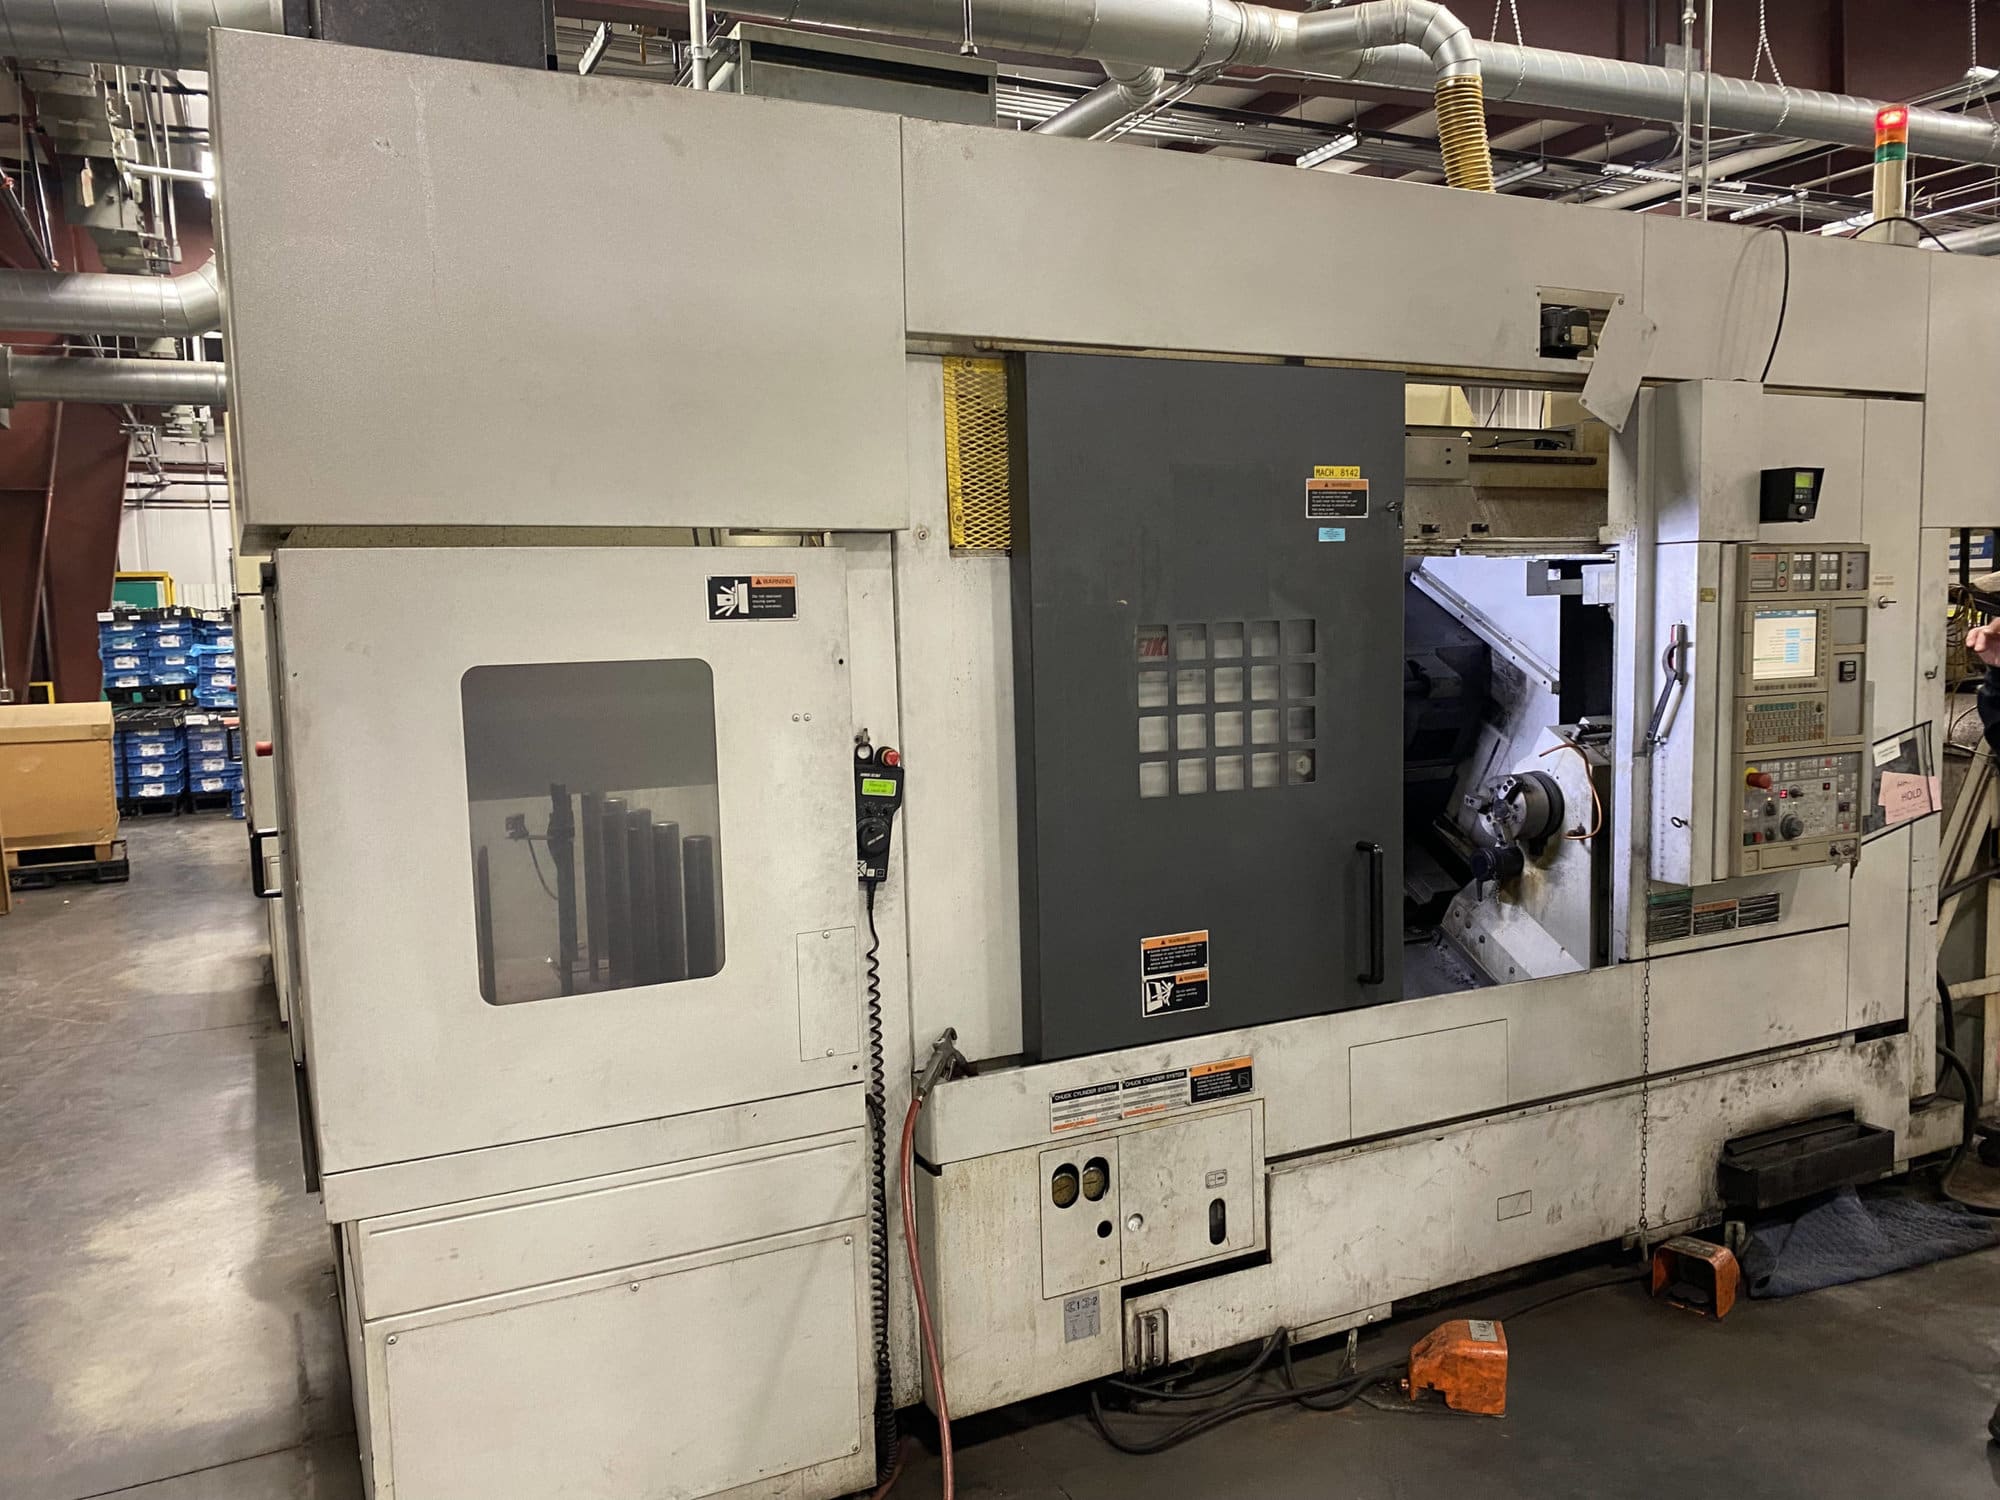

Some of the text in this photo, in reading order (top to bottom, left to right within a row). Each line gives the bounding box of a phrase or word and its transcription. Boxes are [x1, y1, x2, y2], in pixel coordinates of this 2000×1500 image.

[1901, 788, 1923, 801] HOLD
[1125, 1070, 1185, 1088] CHUCK CYLINDER SYSTEM
[1054, 1083, 1118, 1101] CHUCK CYLINDER SYSTEM
